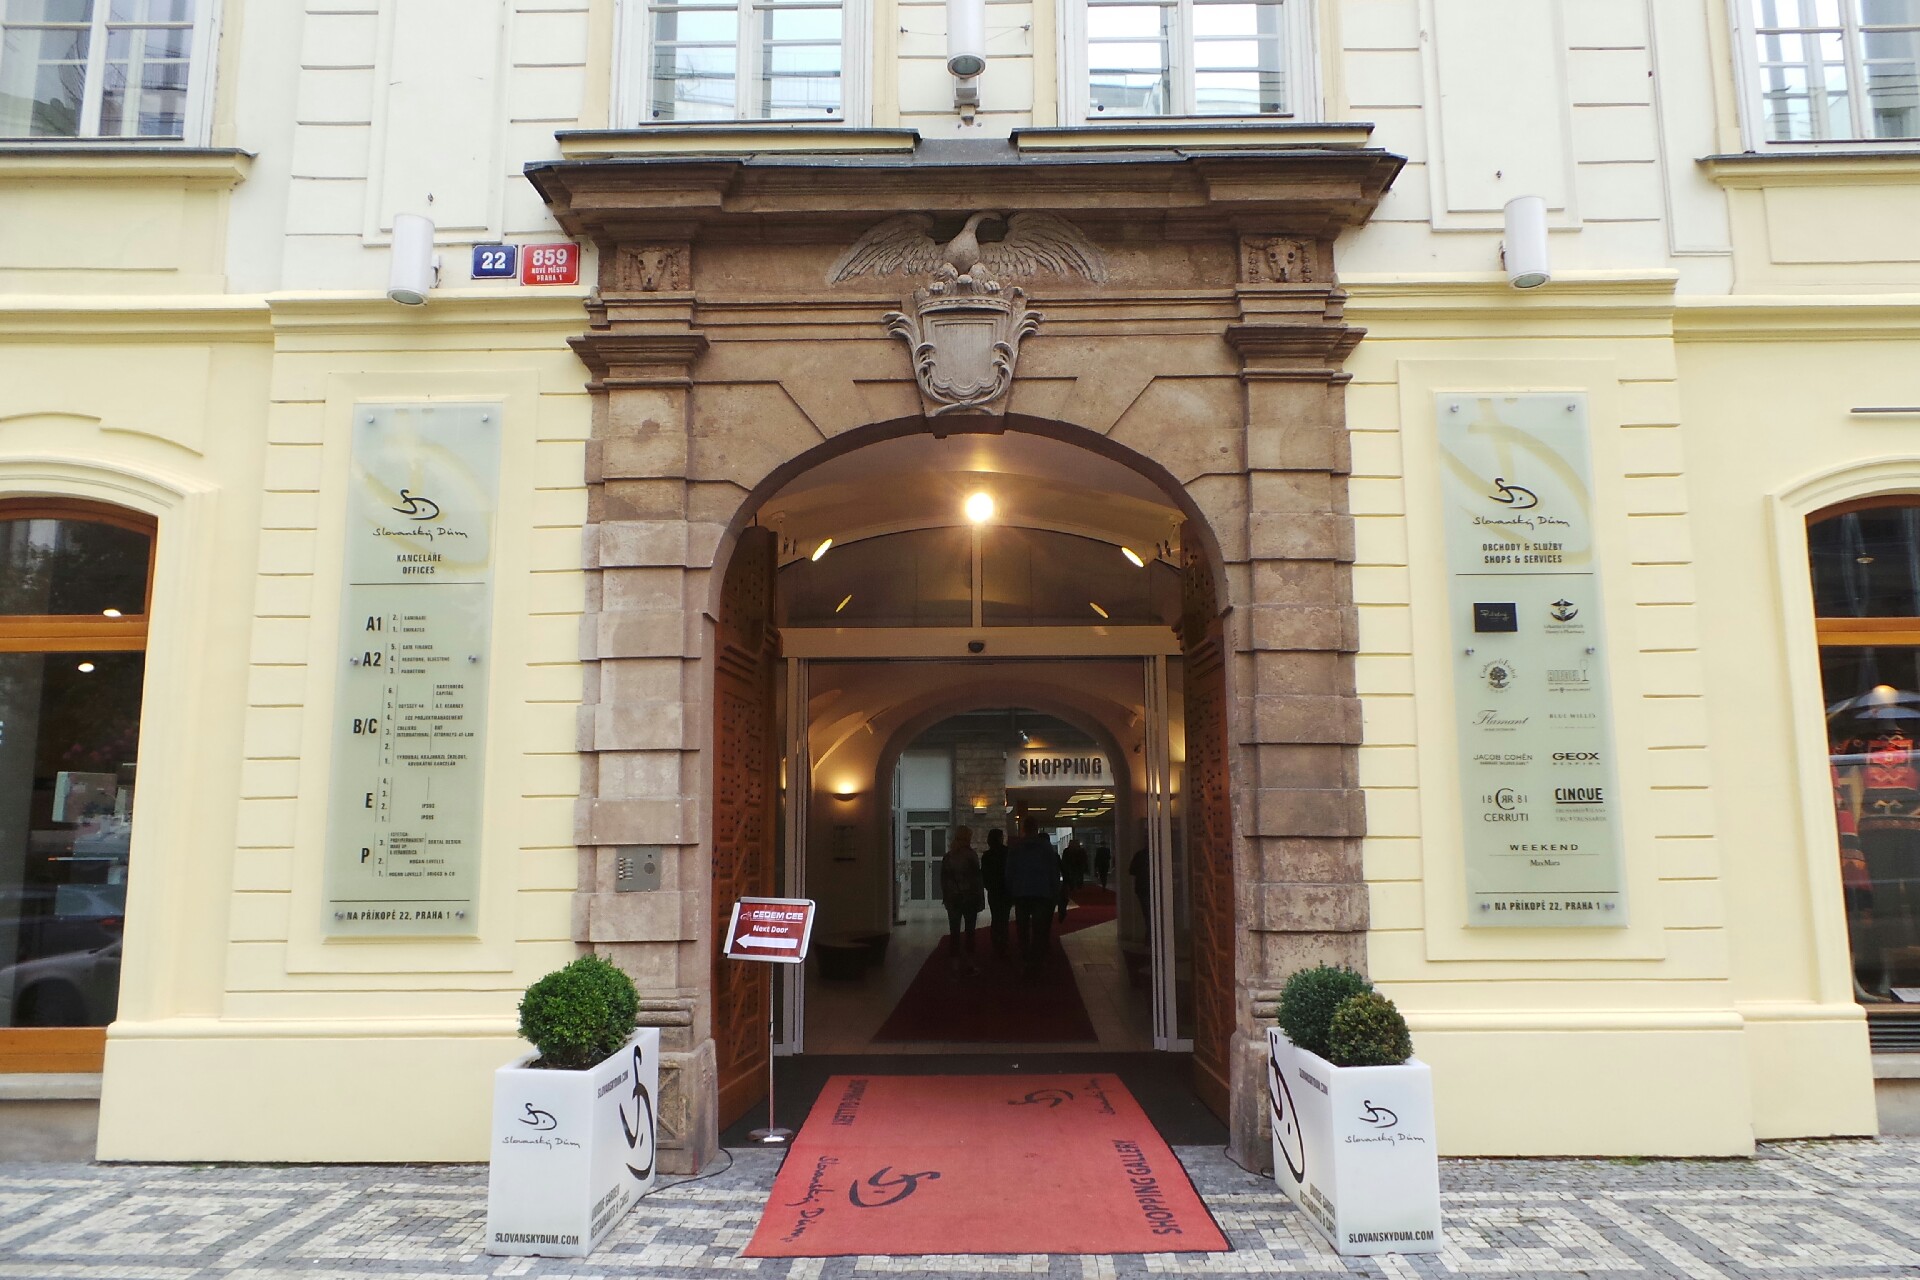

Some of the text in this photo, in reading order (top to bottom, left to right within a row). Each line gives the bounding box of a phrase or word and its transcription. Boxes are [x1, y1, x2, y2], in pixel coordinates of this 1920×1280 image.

[482, 252, 506, 269] 22
[532, 249, 568, 266] 859
[531, 265, 567, 274] NOVÉ MĚSTO
[1483, 541, 1563, 551] OBCHODY & SLUŽBY
[396, 552, 442, 562] KANCELÁŘE
[1484, 555, 1511, 563] SHOPS
[1524, 555, 1562, 563] SERVICES
[402, 566, 435, 575] OFFICES
[366, 616, 382, 631] A1
[362, 652, 382, 667] A2
[1472, 709, 1529, 725] Flamant
[353, 718, 378, 735] B/C
[1552, 752, 1600, 760] GEOX
[1020, 758, 1102, 775] SHOPPING
[1555, 788, 1603, 800] CINQUE
[365, 793, 373, 808] E
[1484, 813, 1529, 822] CERRUTI
[361, 848, 370, 863] P
[1495, 902, 1506, 910] NA
[1510, 900, 1545, 910] PŘÍKOPĚ
[1565, 902, 1593, 910] PRAHA
[1596, 902, 1600, 910] 1
[347, 909, 450, 920] NA PŘÍKOPĚ 22, PRAHA 1
[753, 925, 770, 933] Next
[1112, 1140, 1182, 1234] SHOPPING GALLERY
[495, 1233, 579, 1245] SLOVANSKYDUM.COM
[1348, 1231, 1434, 1243] SLOVANSKYDUM.COM
